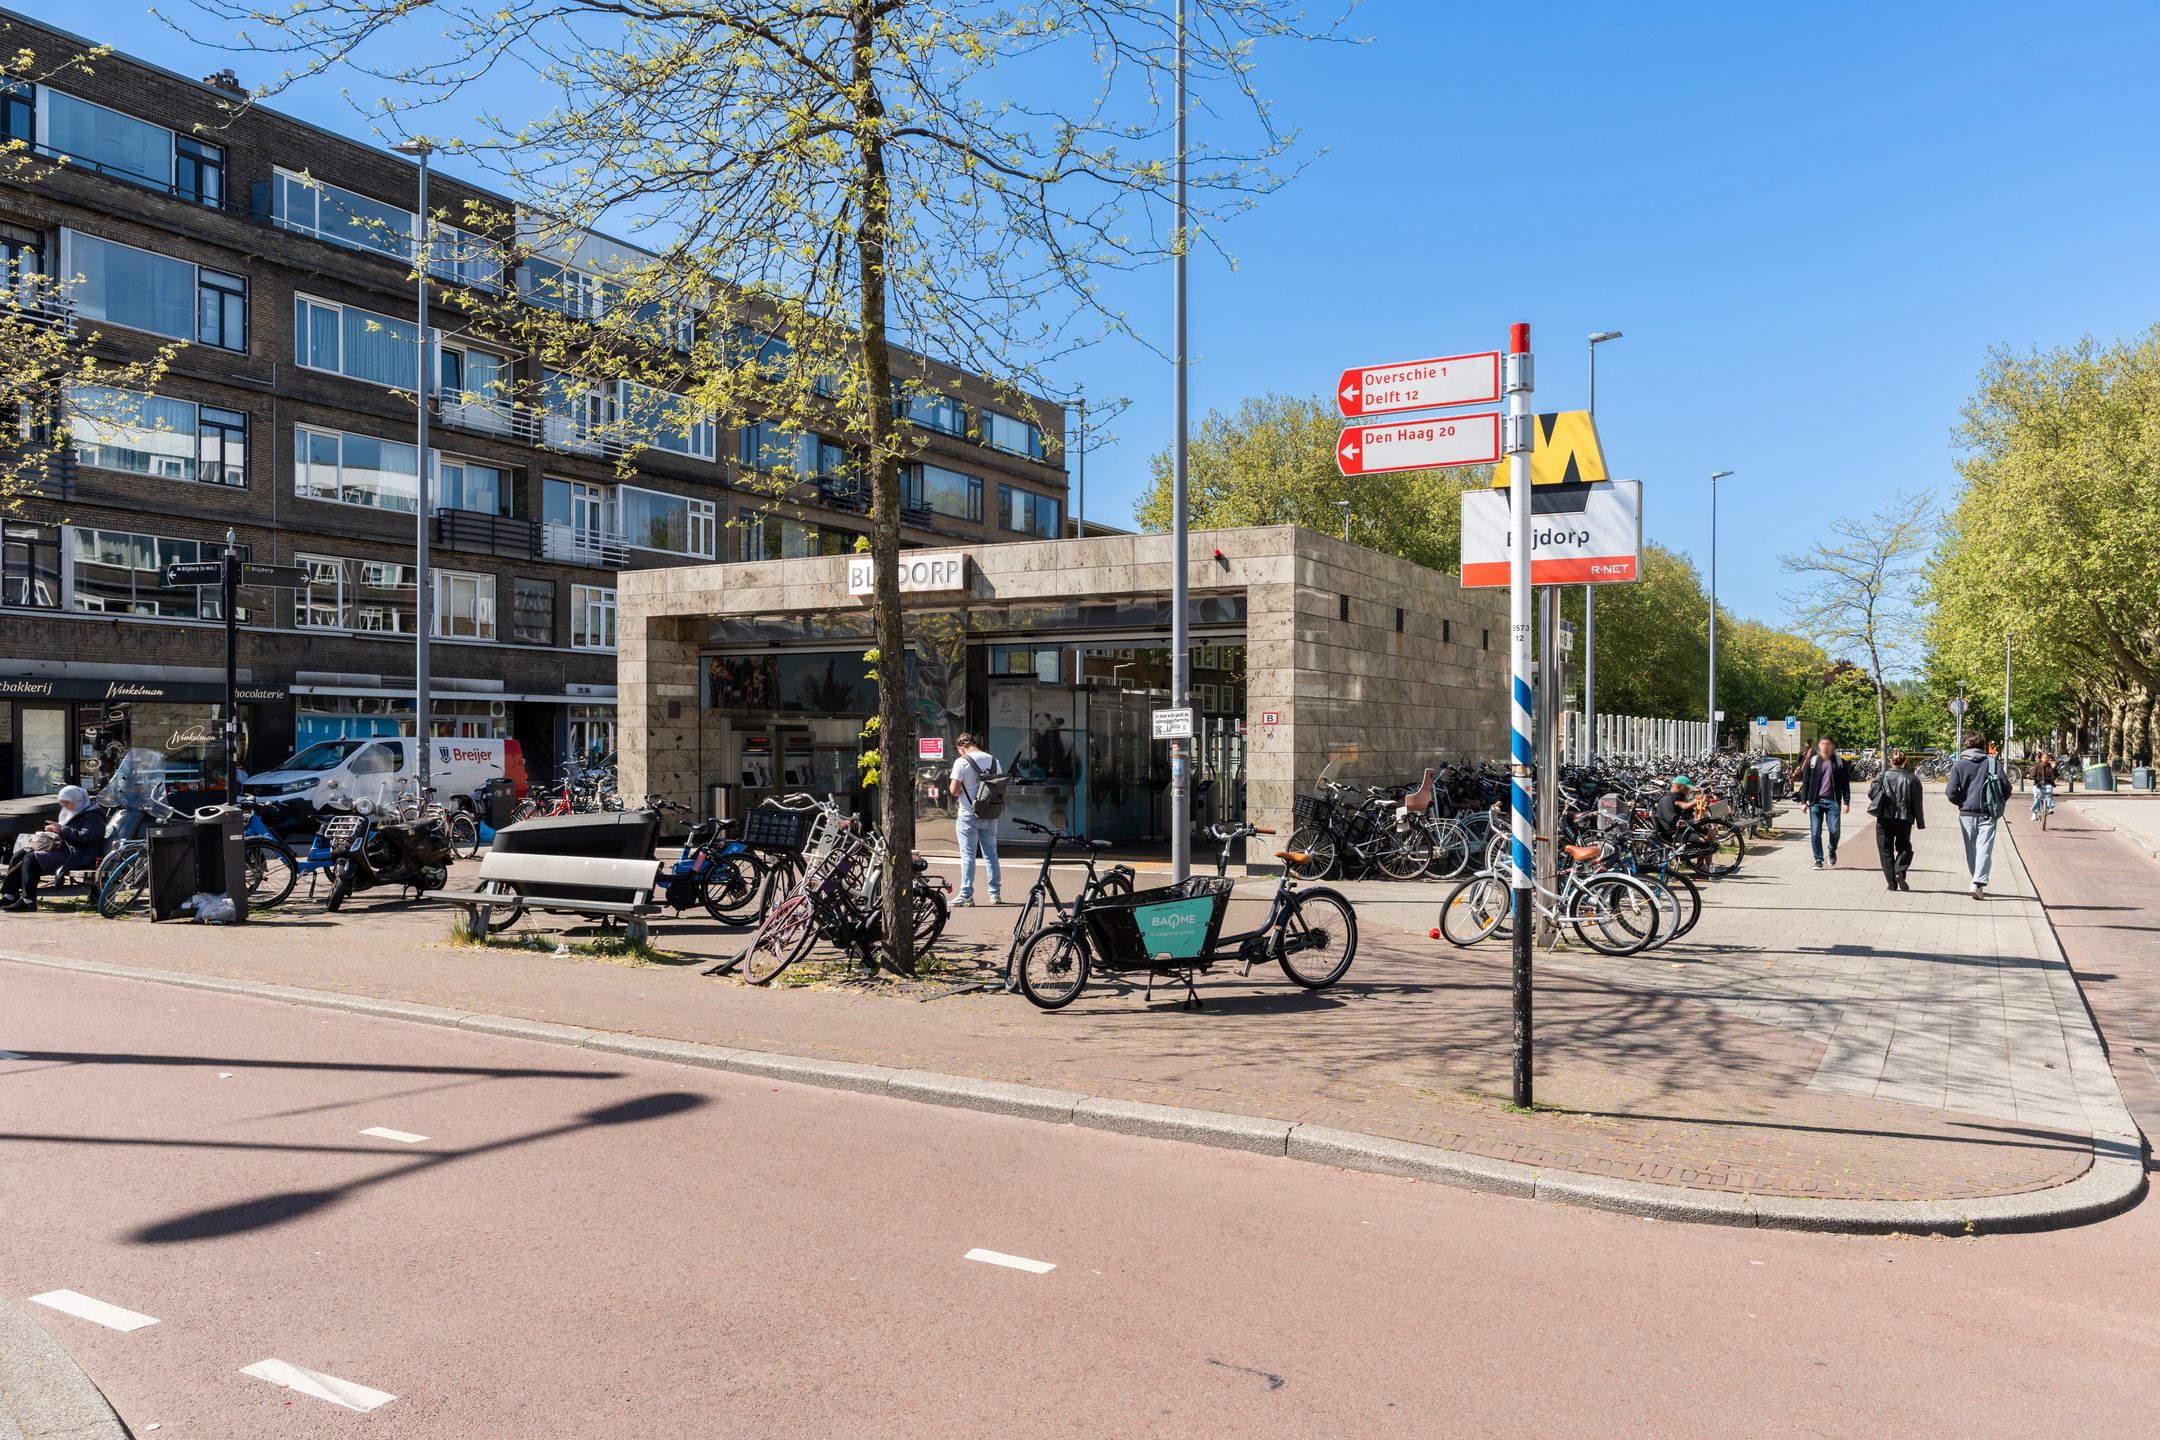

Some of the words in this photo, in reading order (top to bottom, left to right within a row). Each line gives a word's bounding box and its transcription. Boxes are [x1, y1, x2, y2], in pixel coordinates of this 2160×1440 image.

[1365, 368, 1436, 386] Overschie
[1440, 367, 1447, 377] 1
[1365, 391, 1401, 406] Delft
[1405, 391, 1419, 400] 12
[1365, 433, 1392, 444] Den
[1398, 429, 1434, 441] Haag
[1439, 426, 1455, 437] 20
[1507, 528, 1590, 550] jdorp
[251, 566, 274, 574] Blijdorp
[851, 560, 960, 588] BLDORP
[105, 681, 164, 699] Winkelman
[235, 688, 285, 699] hocolaterie
[1266, 714, 1273, 722] B
[172, 730, 216, 745] Winkelman
[453, 748, 492, 764] Breijer
